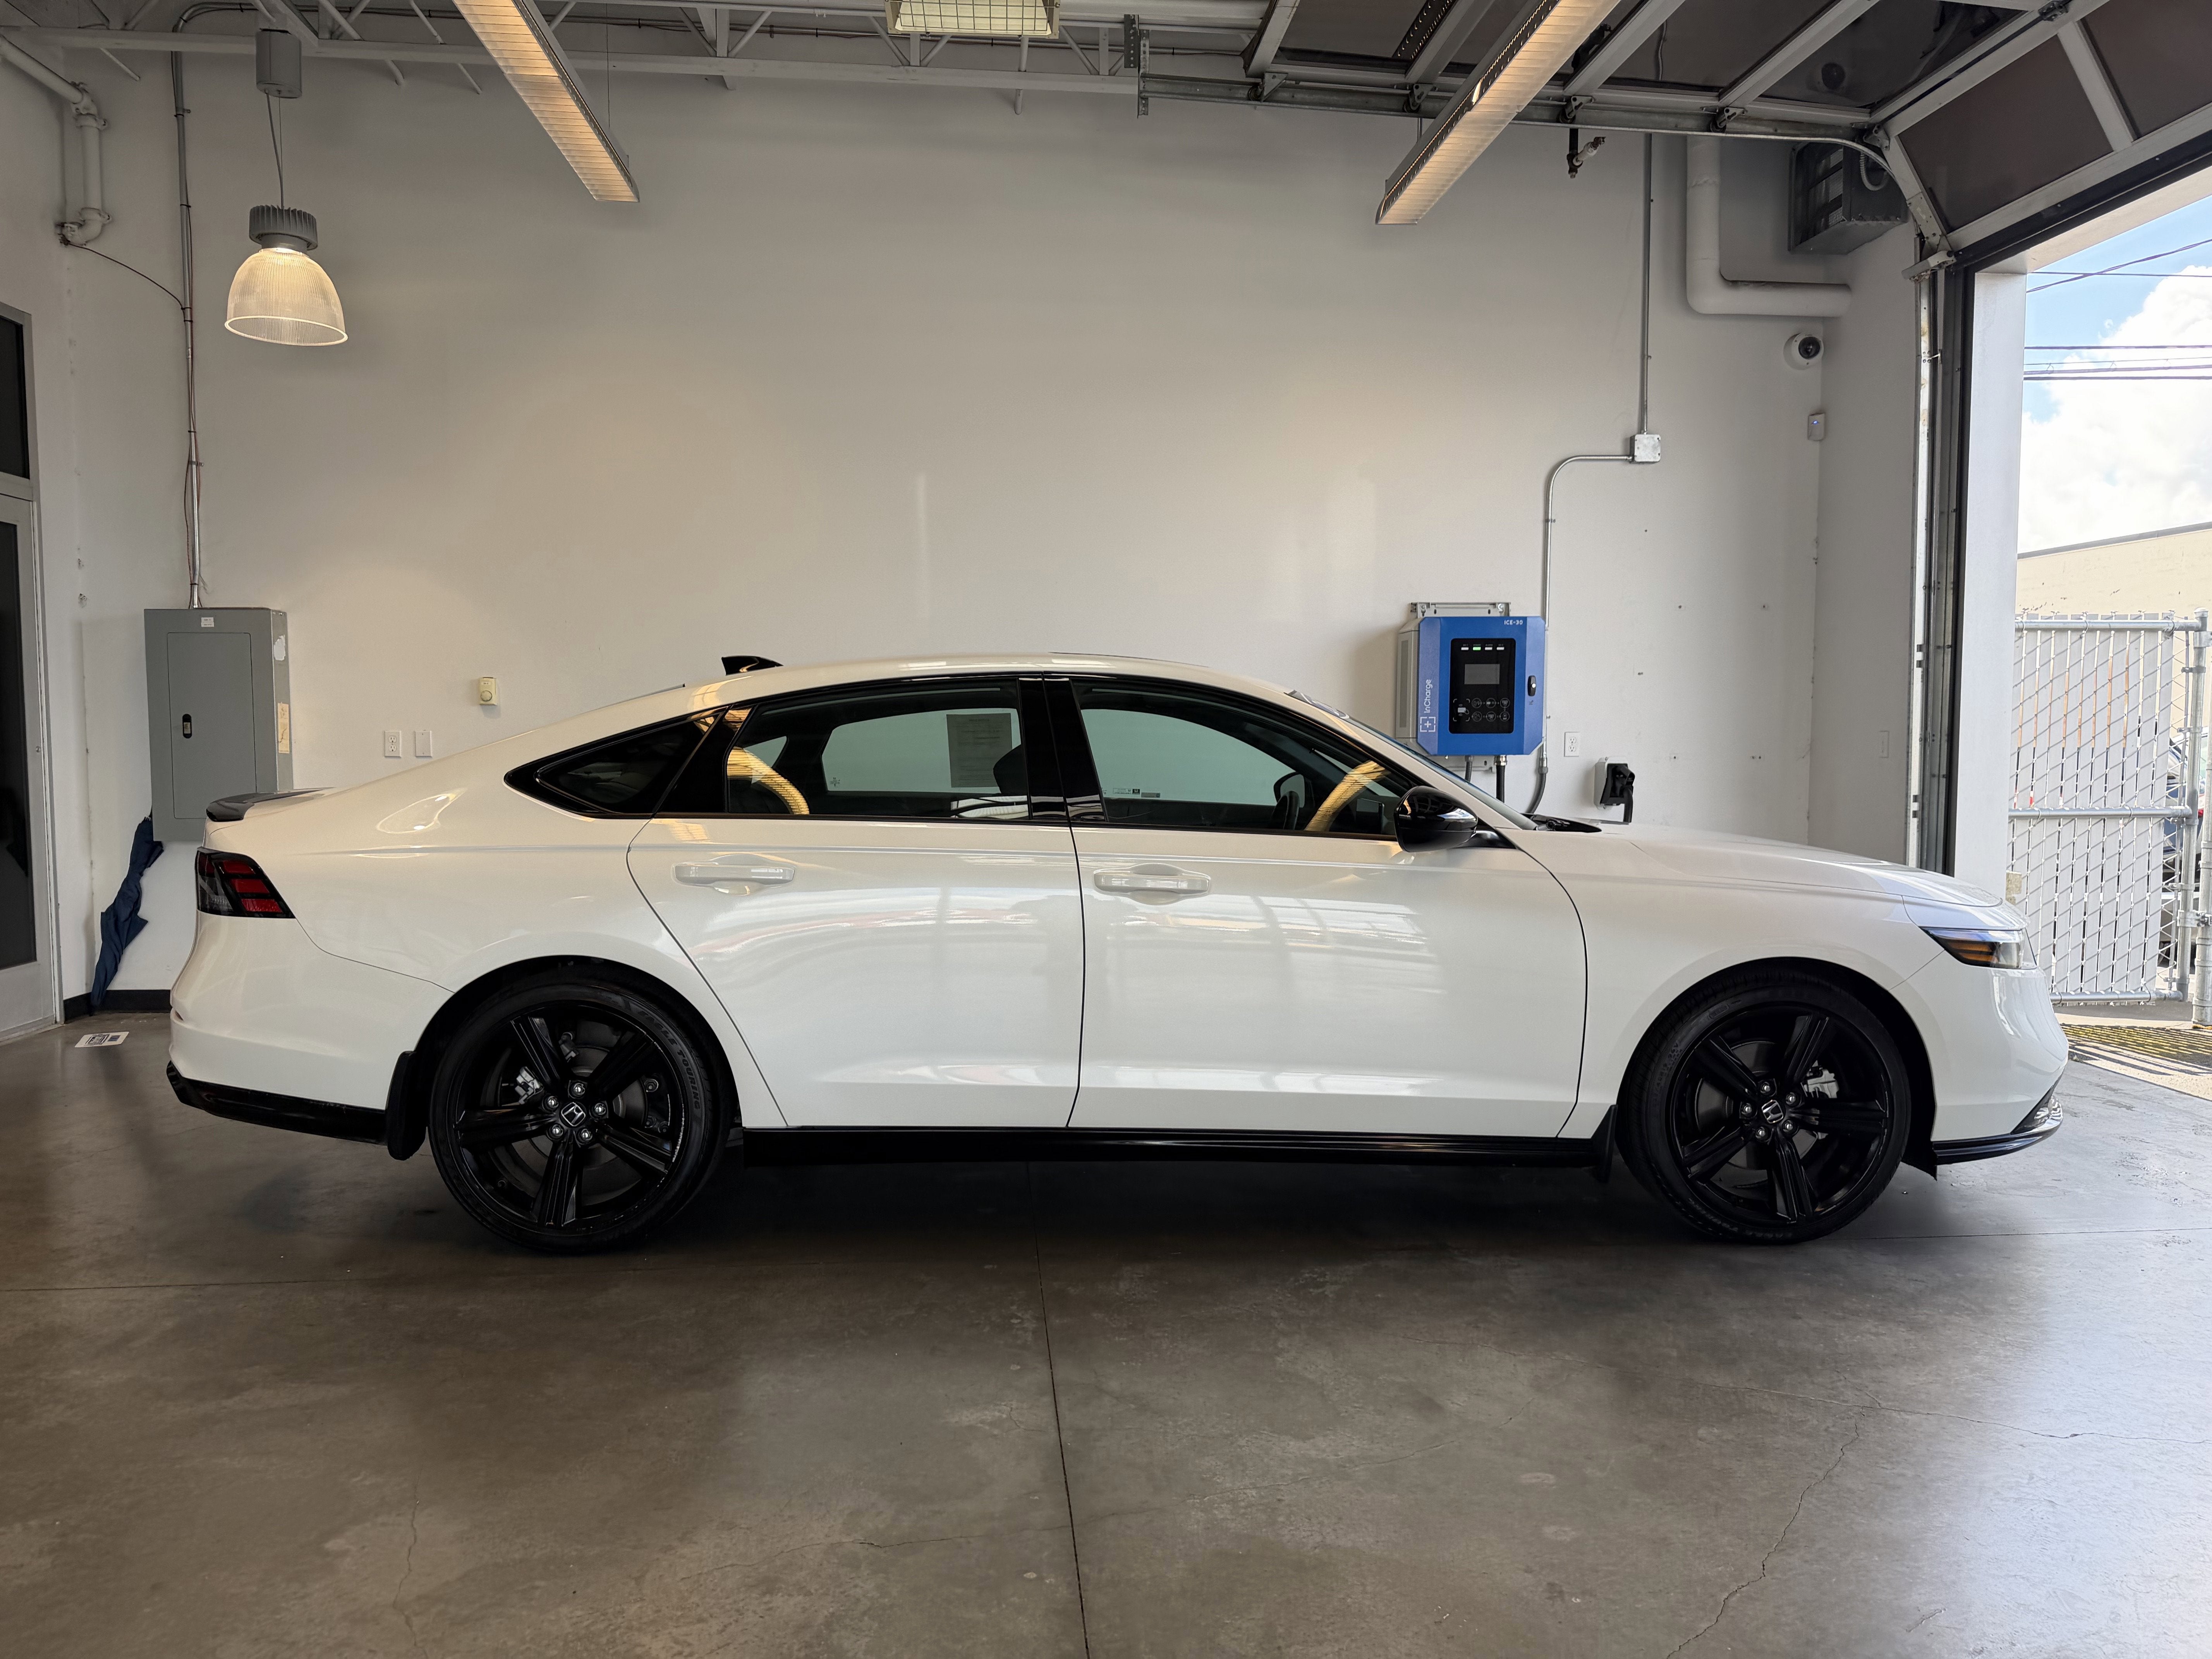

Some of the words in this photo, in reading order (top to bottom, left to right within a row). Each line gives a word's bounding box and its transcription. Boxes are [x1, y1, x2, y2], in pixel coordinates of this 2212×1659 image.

[1424, 679, 1433, 713] InCharge
[637, 1011, 678, 1045] EAGLE
[677, 1049, 700, 1109] TOURING
